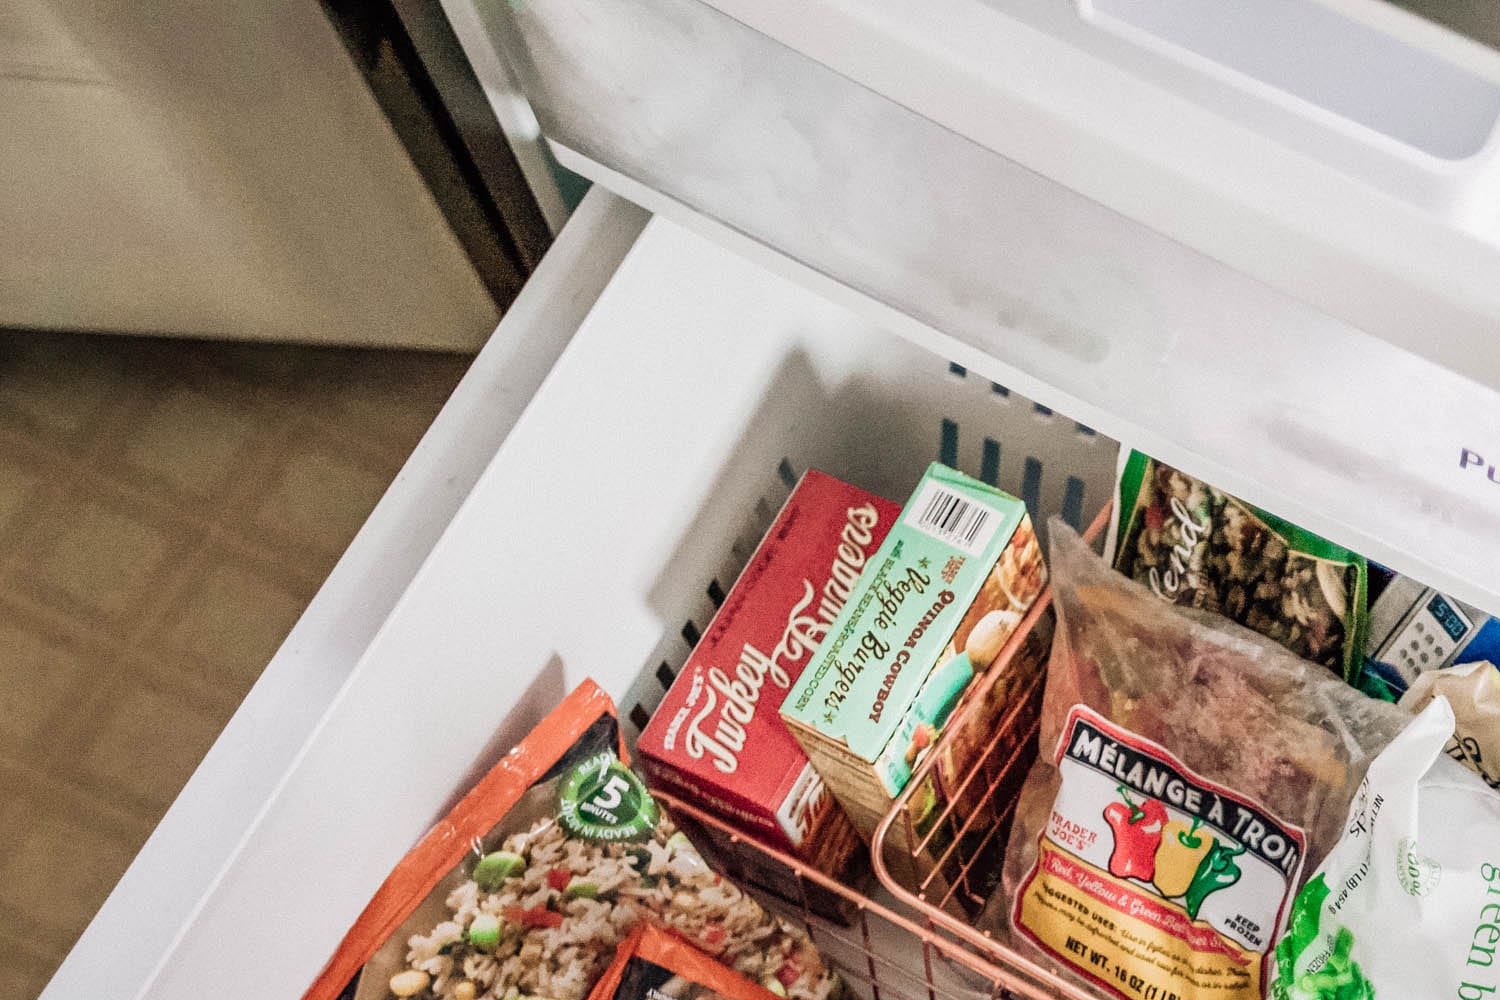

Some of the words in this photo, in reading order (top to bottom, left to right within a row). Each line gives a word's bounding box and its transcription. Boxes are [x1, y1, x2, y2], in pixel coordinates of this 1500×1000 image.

[873, 566, 932, 631] Veggie
[903, 589, 956, 649] QUINOA
[824, 630, 891, 711] Burgers
[868, 649, 912, 725] COWBOY
[685, 642, 791, 773] Turkey
[593, 775, 630, 810] 5
[1073, 729, 1202, 812] MÉLANGE
[1208, 794, 1225, 828] À
[1051, 811, 1098, 845] TRADER
[1223, 917, 1263, 947] FROZEN
[1234, 913, 1262, 933] KEEP
[1065, 935, 1089, 960] NET
[1089, 948, 1111, 972] WT.
[1114, 964, 1129, 983] 16
[1129, 975, 1145, 994] OZ
